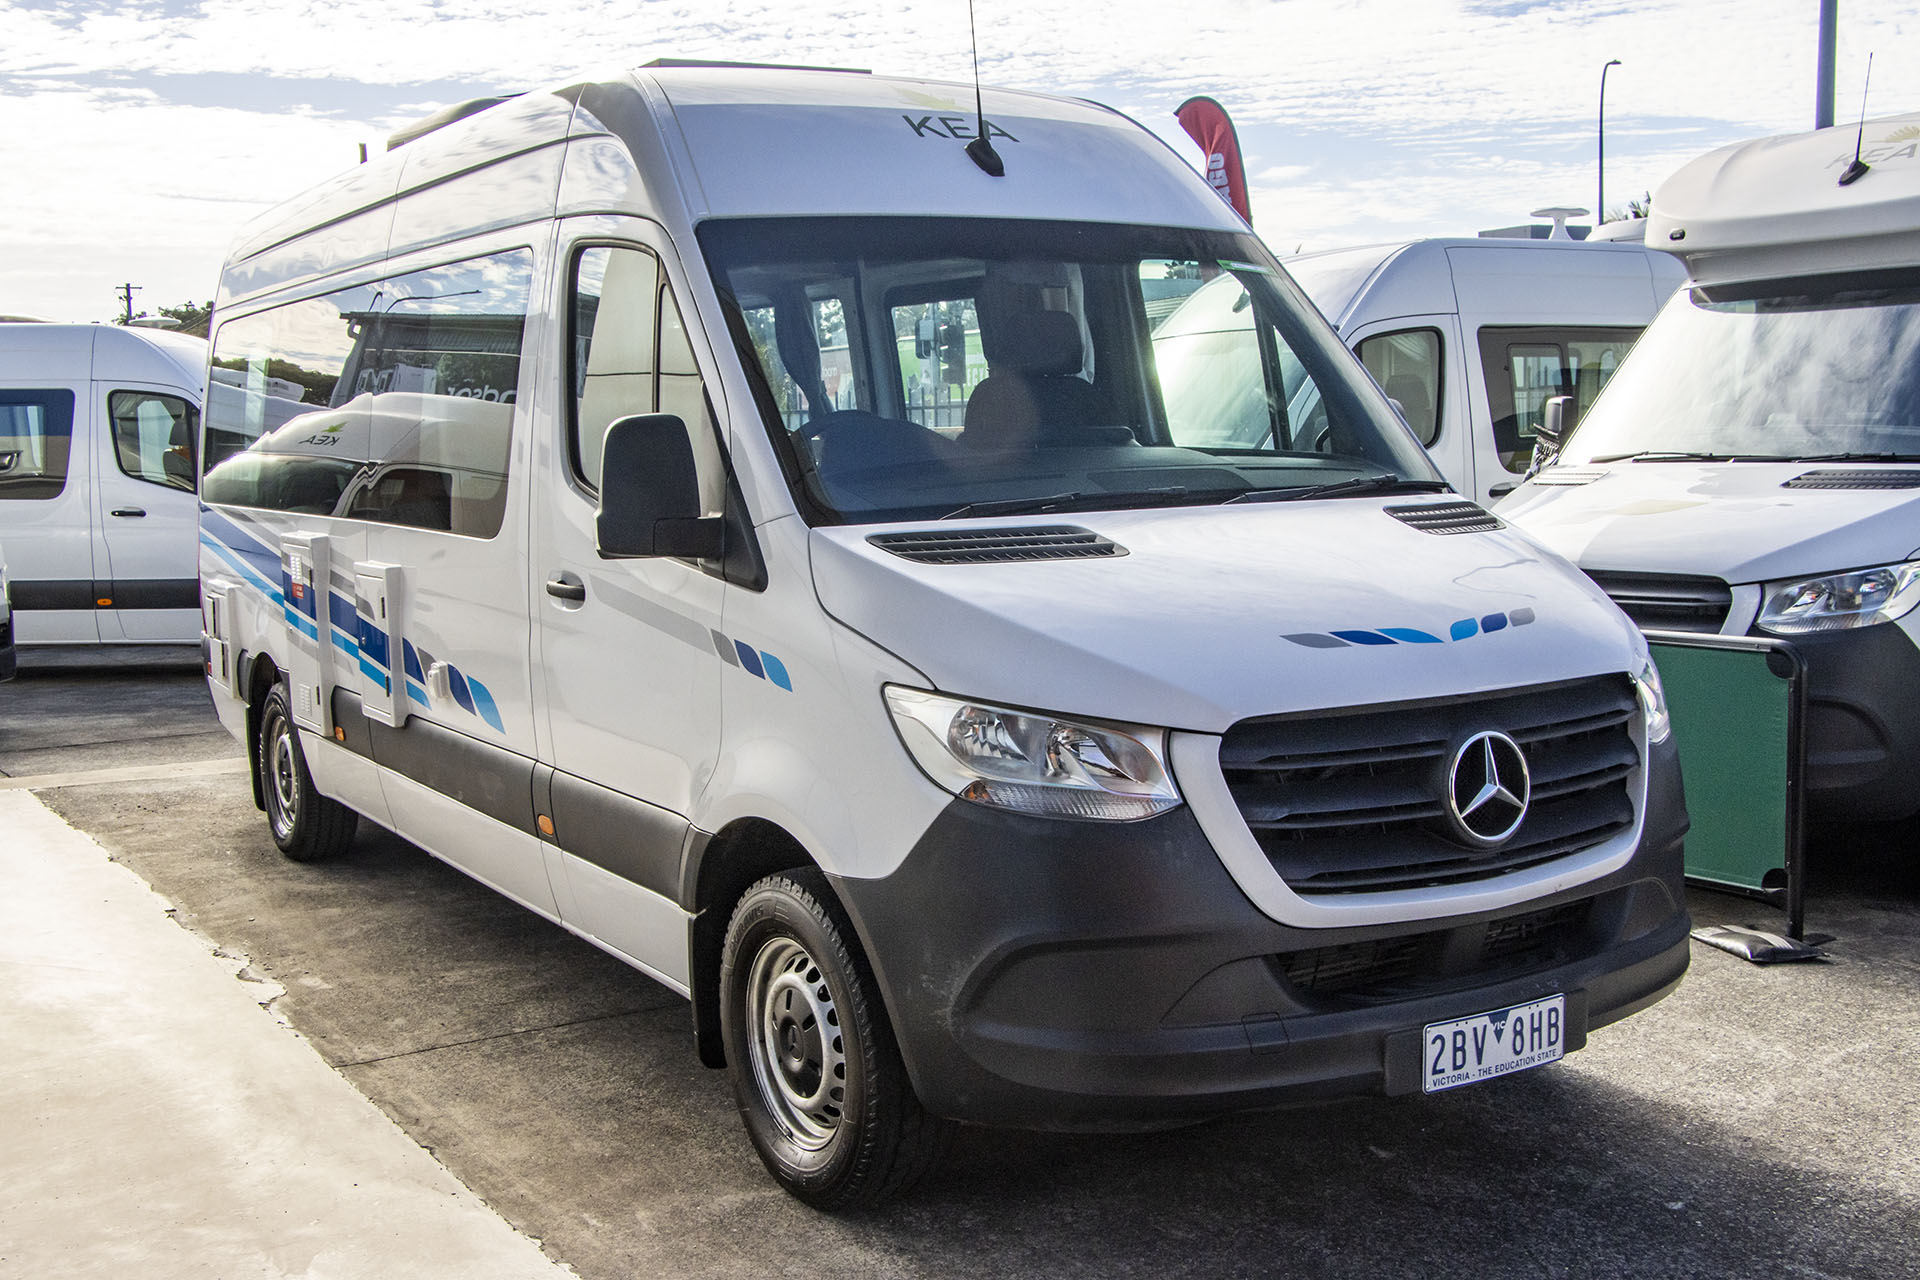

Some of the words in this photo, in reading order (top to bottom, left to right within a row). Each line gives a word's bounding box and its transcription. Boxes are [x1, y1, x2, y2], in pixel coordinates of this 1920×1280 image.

[902, 115, 1020, 142] KEA
[1824, 143, 1917, 168] KEA
[1492, 1020, 1506, 1031] VIC
[1431, 1024, 1487, 1076] 2BV
[1512, 1006, 1560, 1056] 8HB
[1432, 1072, 1470, 1087] VICTORIA
[1478, 1066, 1493, 1078] THE
[1495, 1056, 1536, 1074] EDUCATION
[1536, 1048, 1557, 1062] STATE
